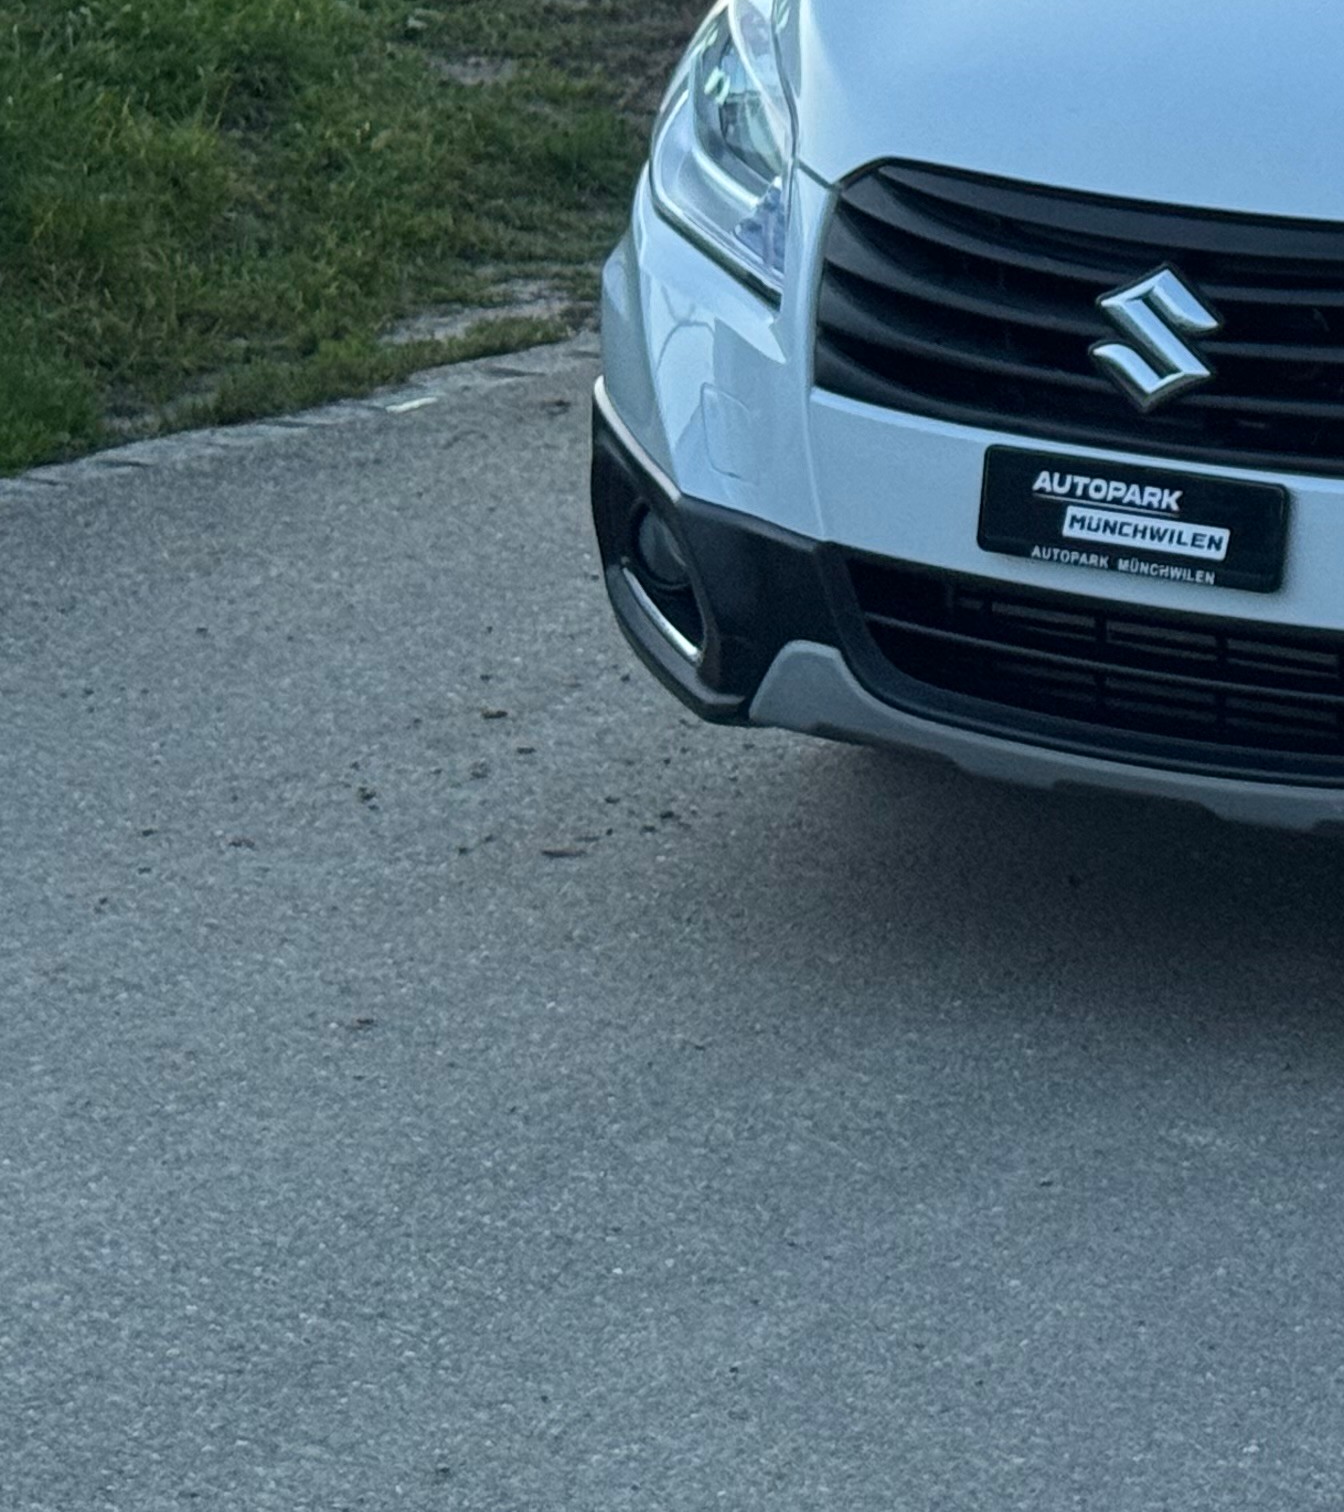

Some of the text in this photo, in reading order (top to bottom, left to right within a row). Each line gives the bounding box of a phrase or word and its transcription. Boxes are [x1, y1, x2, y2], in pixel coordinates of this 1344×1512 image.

[1032, 470, 1183, 511] AUTOPARK
[1031, 545, 1216, 585] AUTOPARK MÜNCHWILEN
